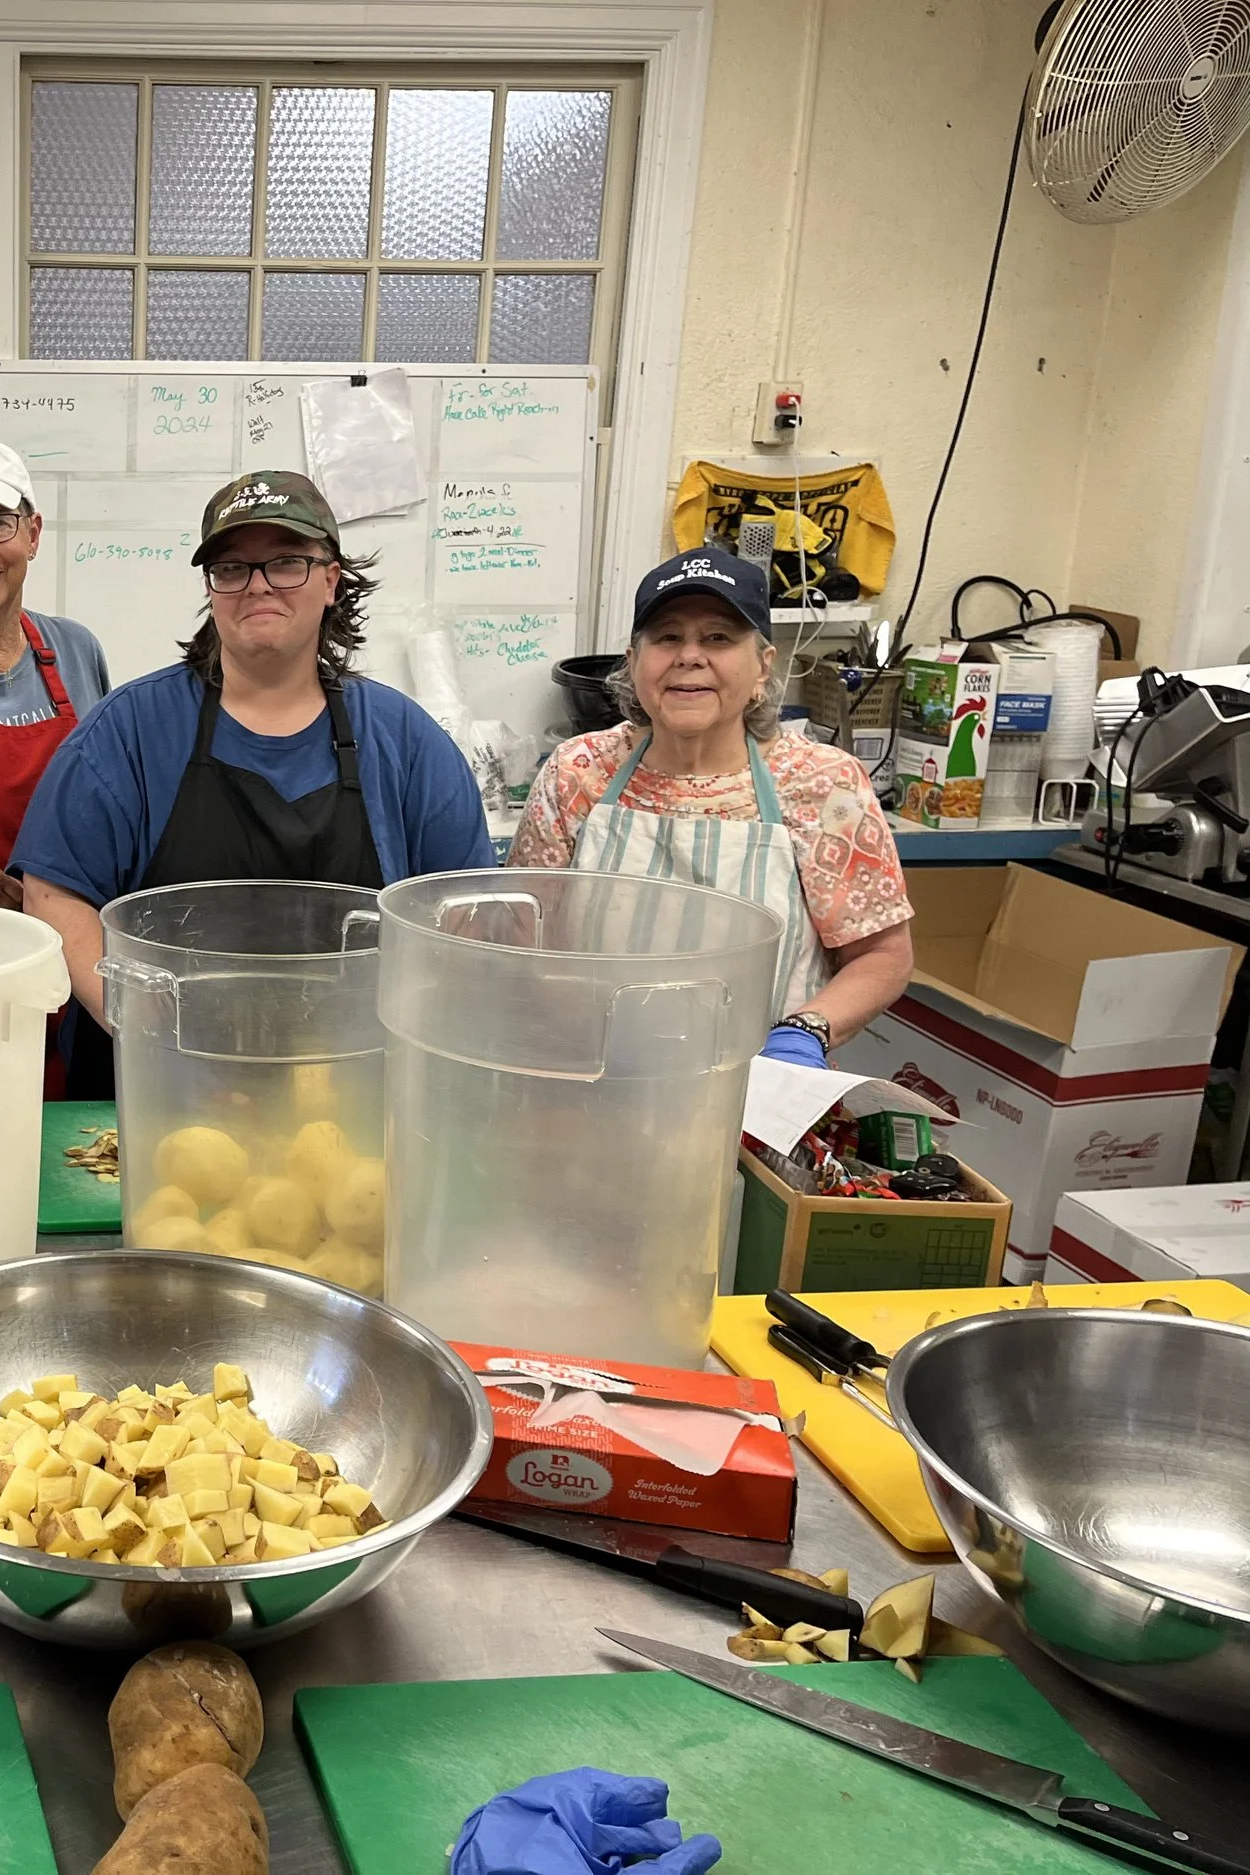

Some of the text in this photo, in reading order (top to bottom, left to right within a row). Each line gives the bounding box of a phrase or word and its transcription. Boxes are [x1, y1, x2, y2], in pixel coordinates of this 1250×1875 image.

[151, 386, 218, 411] May 30
[153, 414, 213, 435] 2024
[258, 494, 290, 506] ARMY
[681, 559, 711, 571] LCC
[656, 568, 736, 590] Soup Kitchen
[964, 674, 992, 684] CORN
[963, 684, 991, 692] FLAKES
[1022, 701, 1046, 709] MASK
[526, 1422, 599, 1438] PRIME SIZE
[520, 1461, 599, 1489] Logan
[563, 1488, 591, 1499] WRAP
[634, 1479, 698, 1496] Interfolded
[627, 1490, 702, 1509] Waxed Paper
